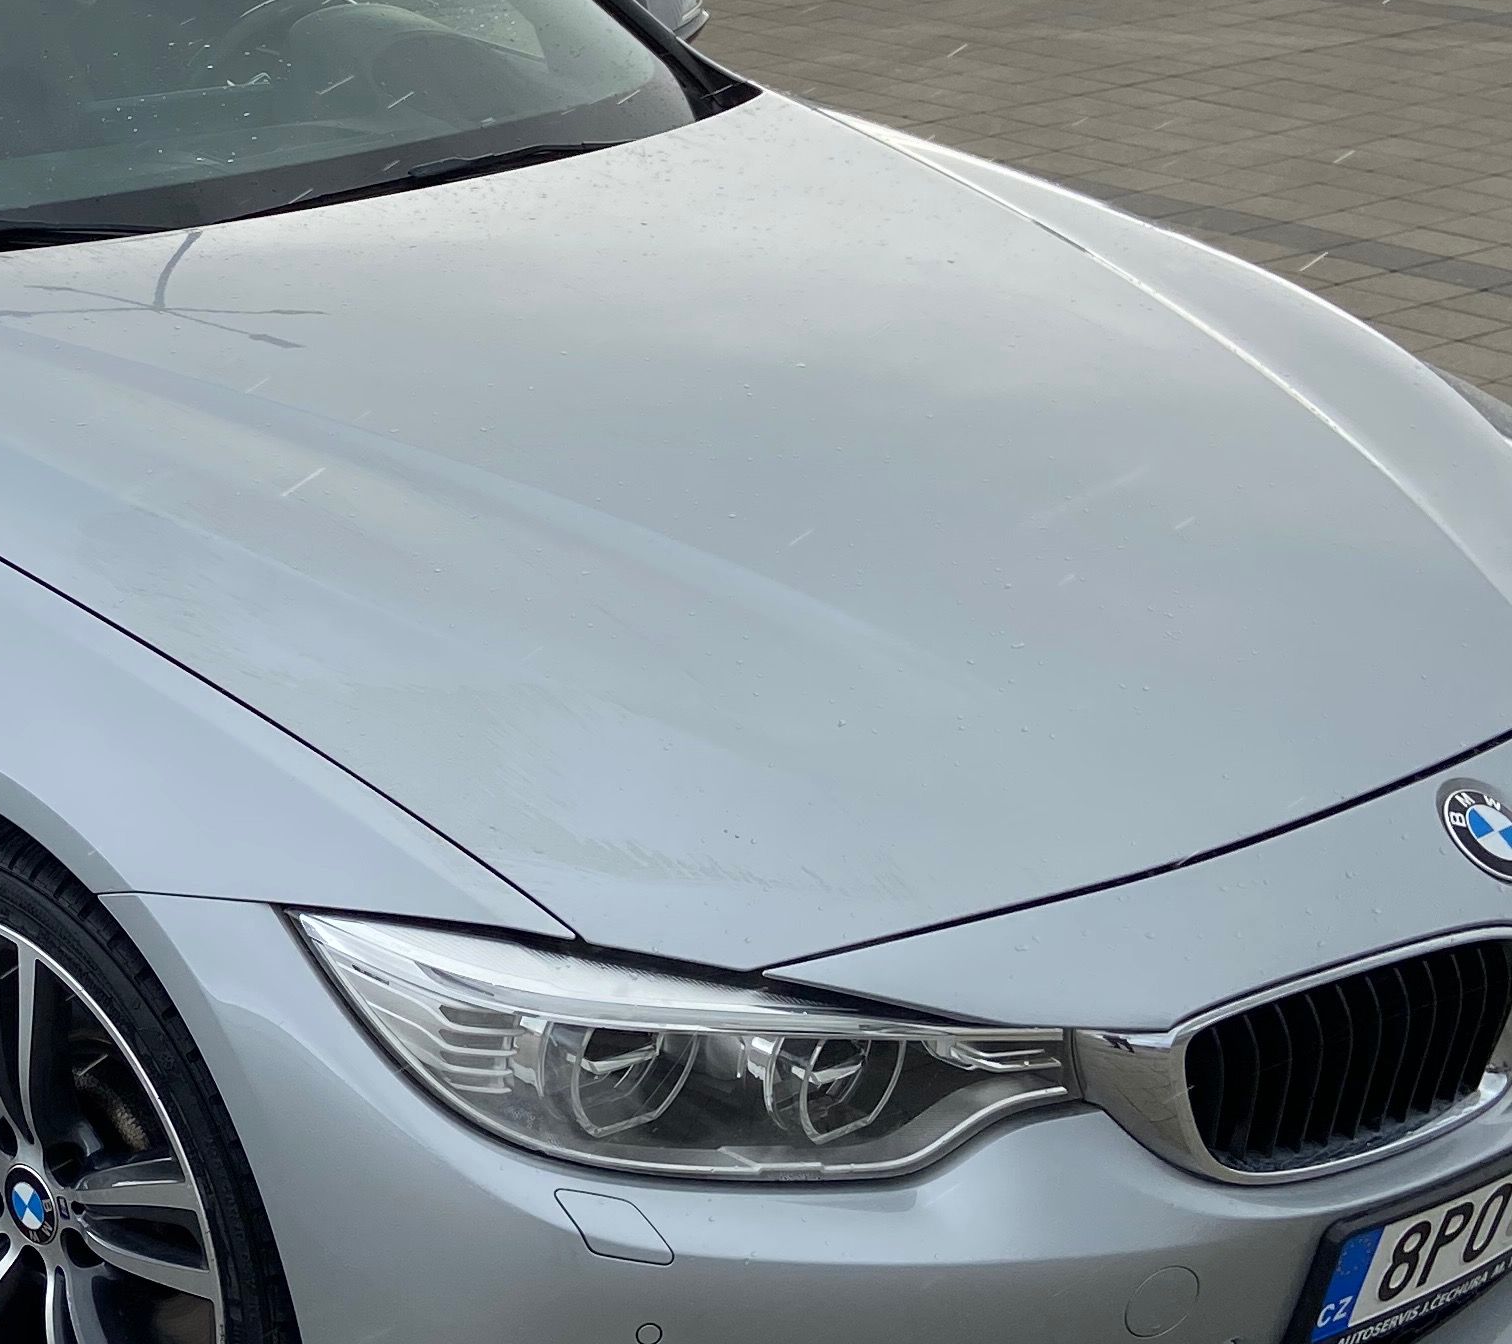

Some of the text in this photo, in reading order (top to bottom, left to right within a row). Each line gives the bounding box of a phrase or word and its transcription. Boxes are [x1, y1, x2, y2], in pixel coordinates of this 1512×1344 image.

[1449, 792, 1501, 828] BMW
[29, 1198, 53, 1243] BMW
[1316, 1295, 1353, 1328] CZ
